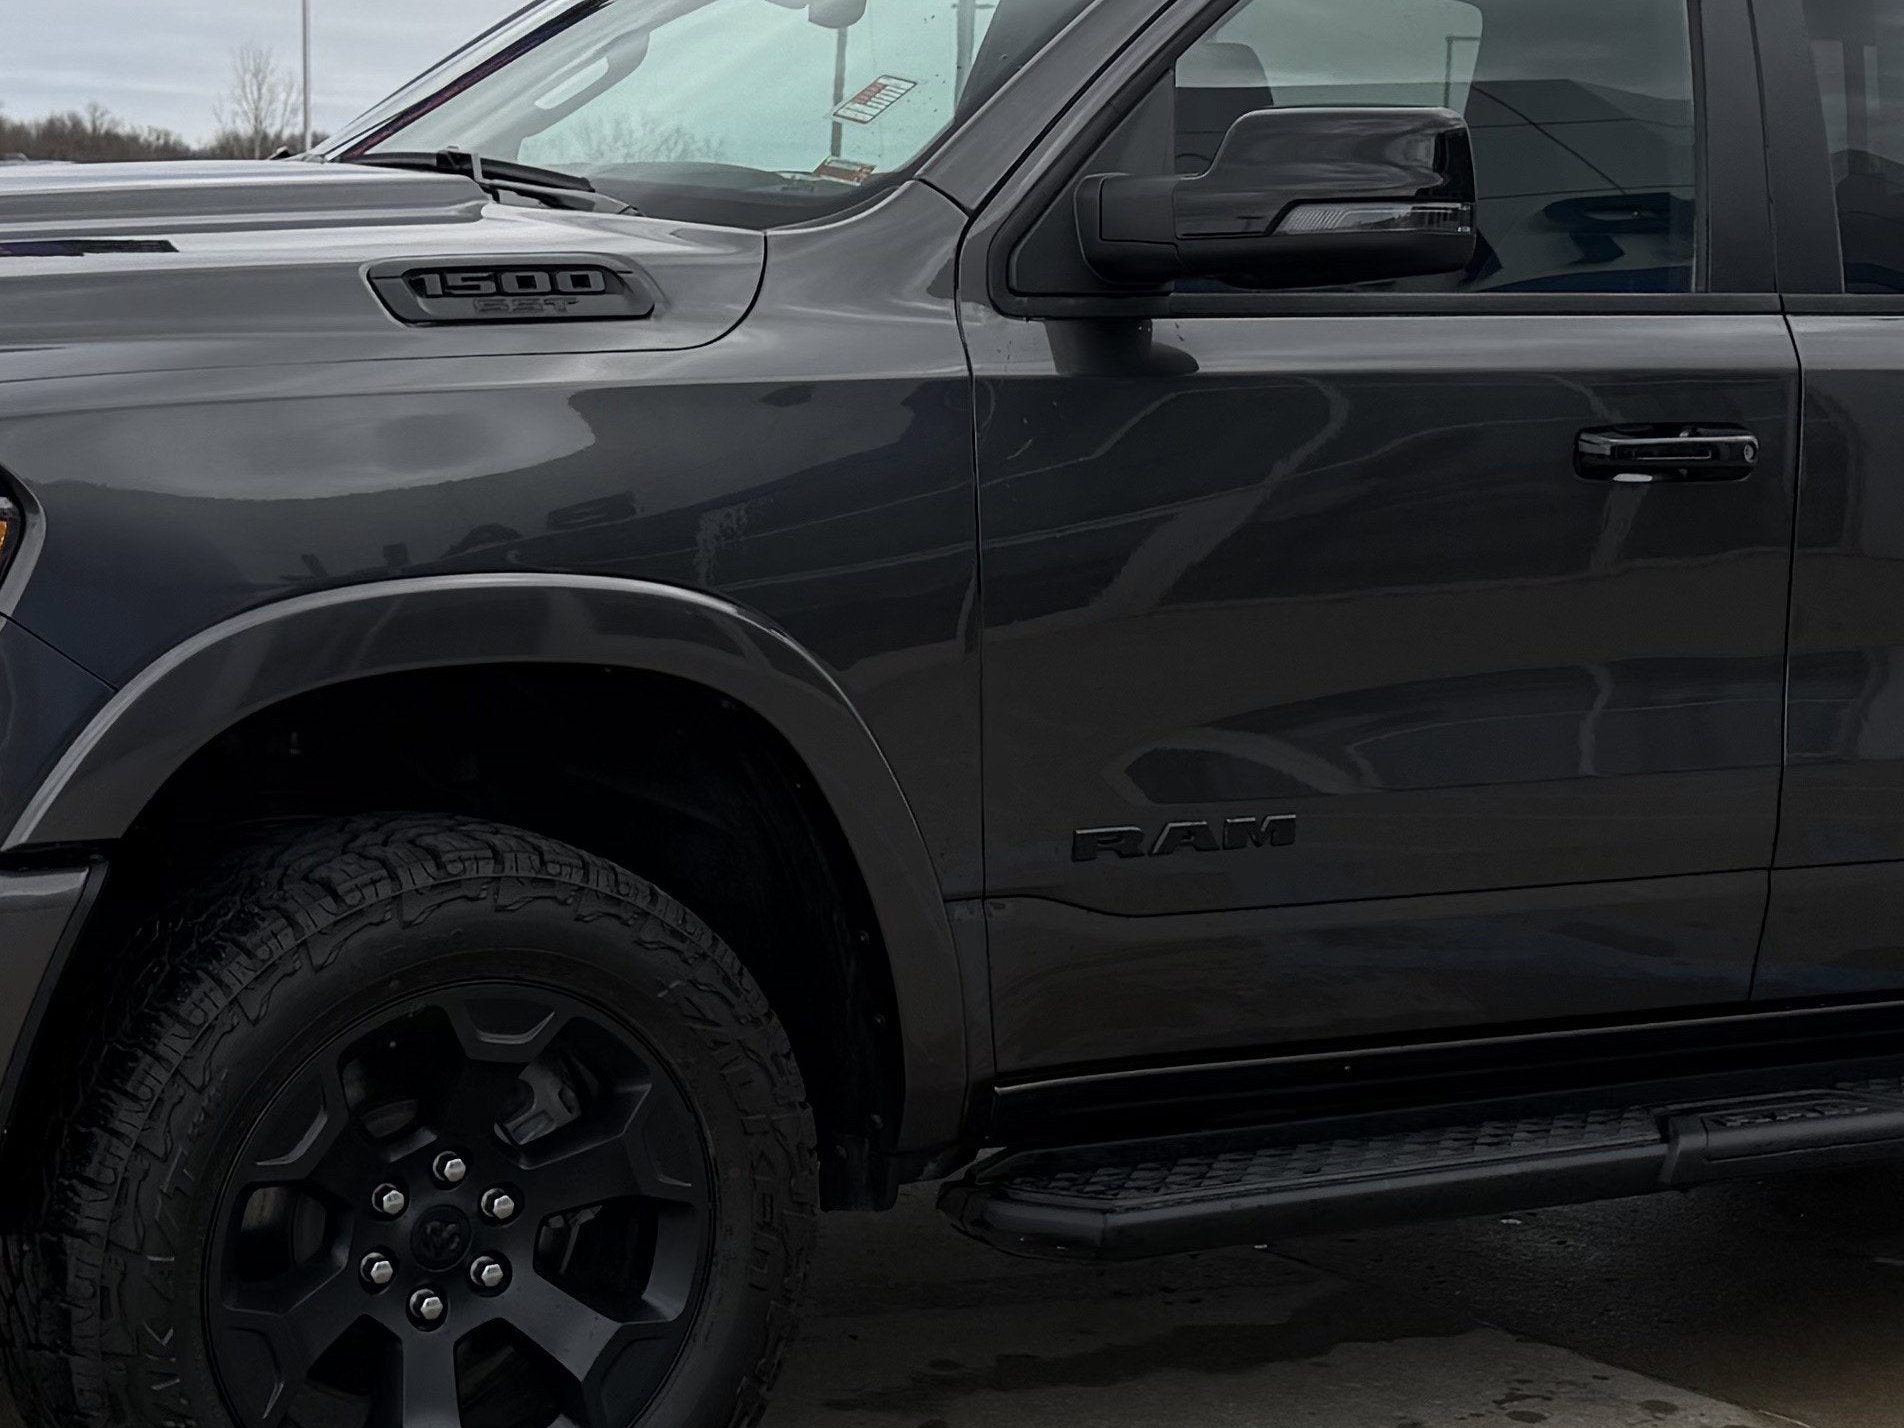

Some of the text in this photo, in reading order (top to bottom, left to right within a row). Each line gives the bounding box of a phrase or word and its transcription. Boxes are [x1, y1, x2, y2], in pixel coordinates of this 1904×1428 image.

[410, 270, 606, 297] 1500
[472, 297, 580, 314] SST
[1071, 813, 1298, 863] RAM
